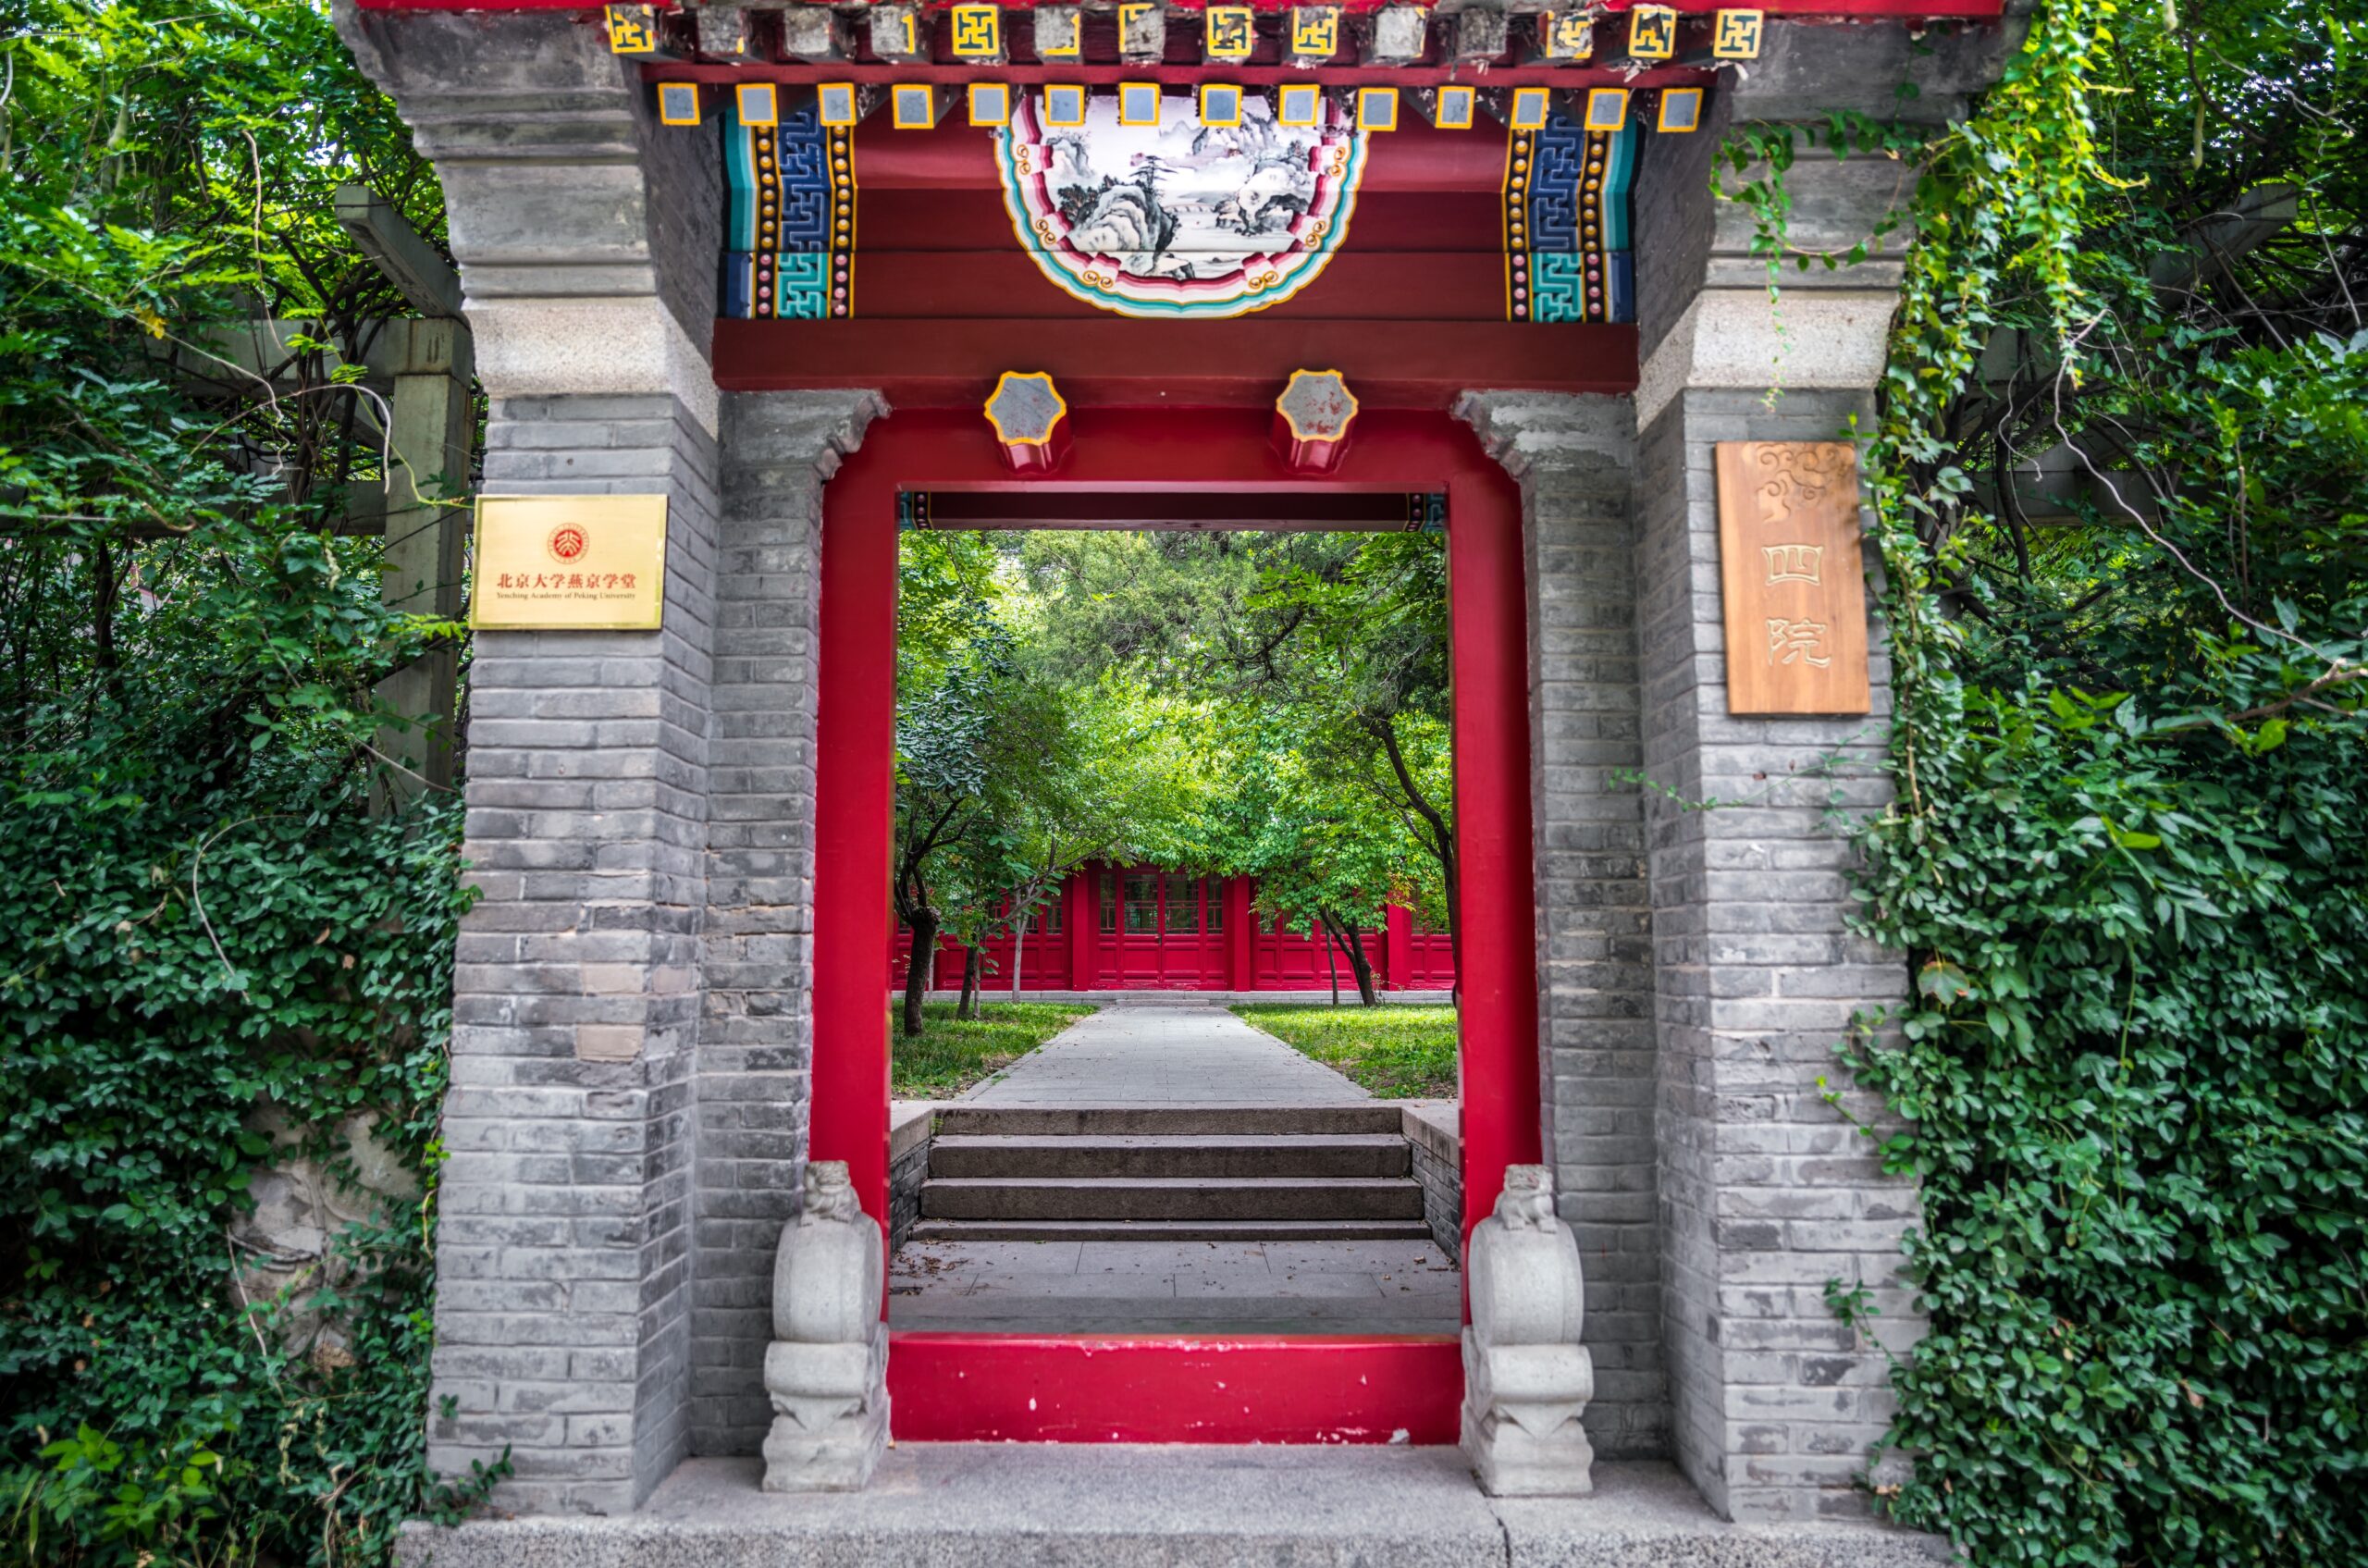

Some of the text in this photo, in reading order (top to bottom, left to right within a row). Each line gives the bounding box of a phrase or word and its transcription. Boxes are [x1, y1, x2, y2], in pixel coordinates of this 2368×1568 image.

[497, 573, 636, 589] 北京大学燕京学堂
[497, 592, 528, 600] Yenching
[531, 592, 562, 600] Academy
[574, 592, 598, 600] Peking
[599, 592, 635, 600] University
[1761, 543, 1832, 669] 四院
